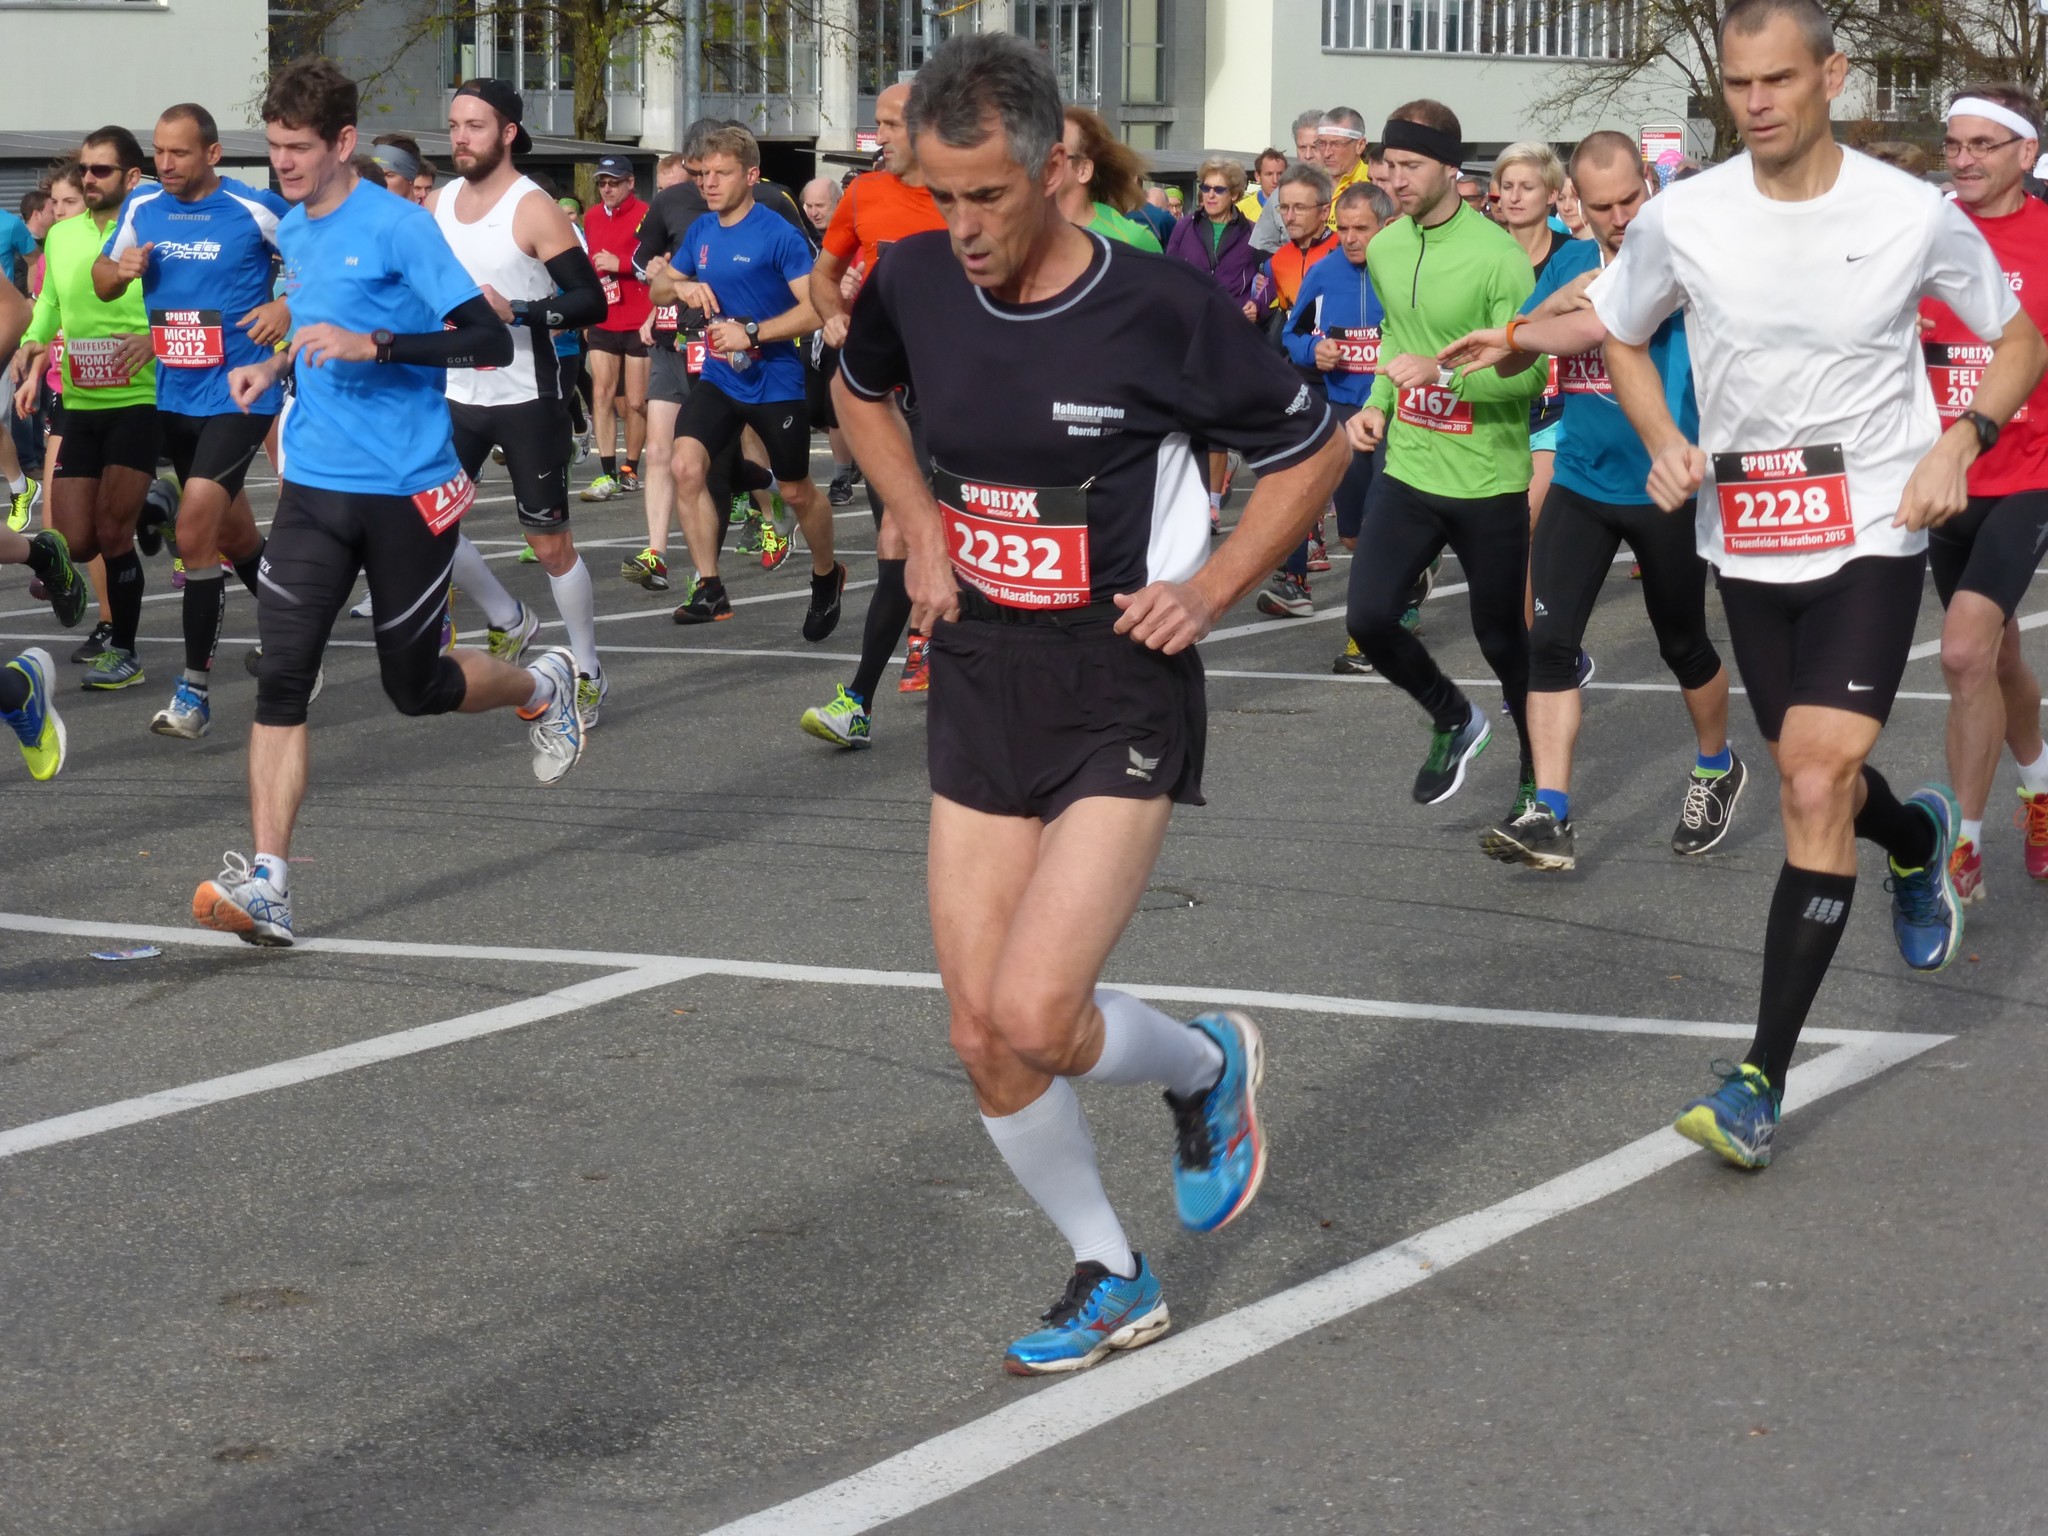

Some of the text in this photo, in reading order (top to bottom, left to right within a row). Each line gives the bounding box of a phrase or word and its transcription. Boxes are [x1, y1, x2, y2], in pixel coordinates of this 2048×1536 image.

[168, 213, 211, 221] noname
[162, 251, 218, 262] ACTION
[165, 311, 201, 325] SPORTXX
[657, 305, 677, 320] 224
[164, 328, 207, 341] MICHA
[71, 341, 119, 351] RAIFFEISEN
[166, 341, 205, 356] 2012
[1340, 344, 1380, 362] 220
[73, 354, 113, 366] THOMA
[447, 355, 474, 364] GORE
[79, 366, 113, 378] 2021
[1948, 369, 1984, 386] FEL
[1405, 387, 1459, 417] 2167
[1946, 387, 1974, 406] 20
[1053, 402, 1125, 419] Halbmarathon
[1453, 423, 1467, 432] 2015
[1740, 450, 1808, 475] SPORTXX
[960, 484, 1041, 518] SPORTXX
[1734, 486, 1830, 528] 2228
[986, 508, 1013, 518] MIGROS
[1731, 529, 1847, 550] Frauenfelder Marathon 2015
[954, 522, 1063, 580] 2232
[1000, 586, 1051, 604] Marathon
[1053, 593, 1079, 605] 2015
